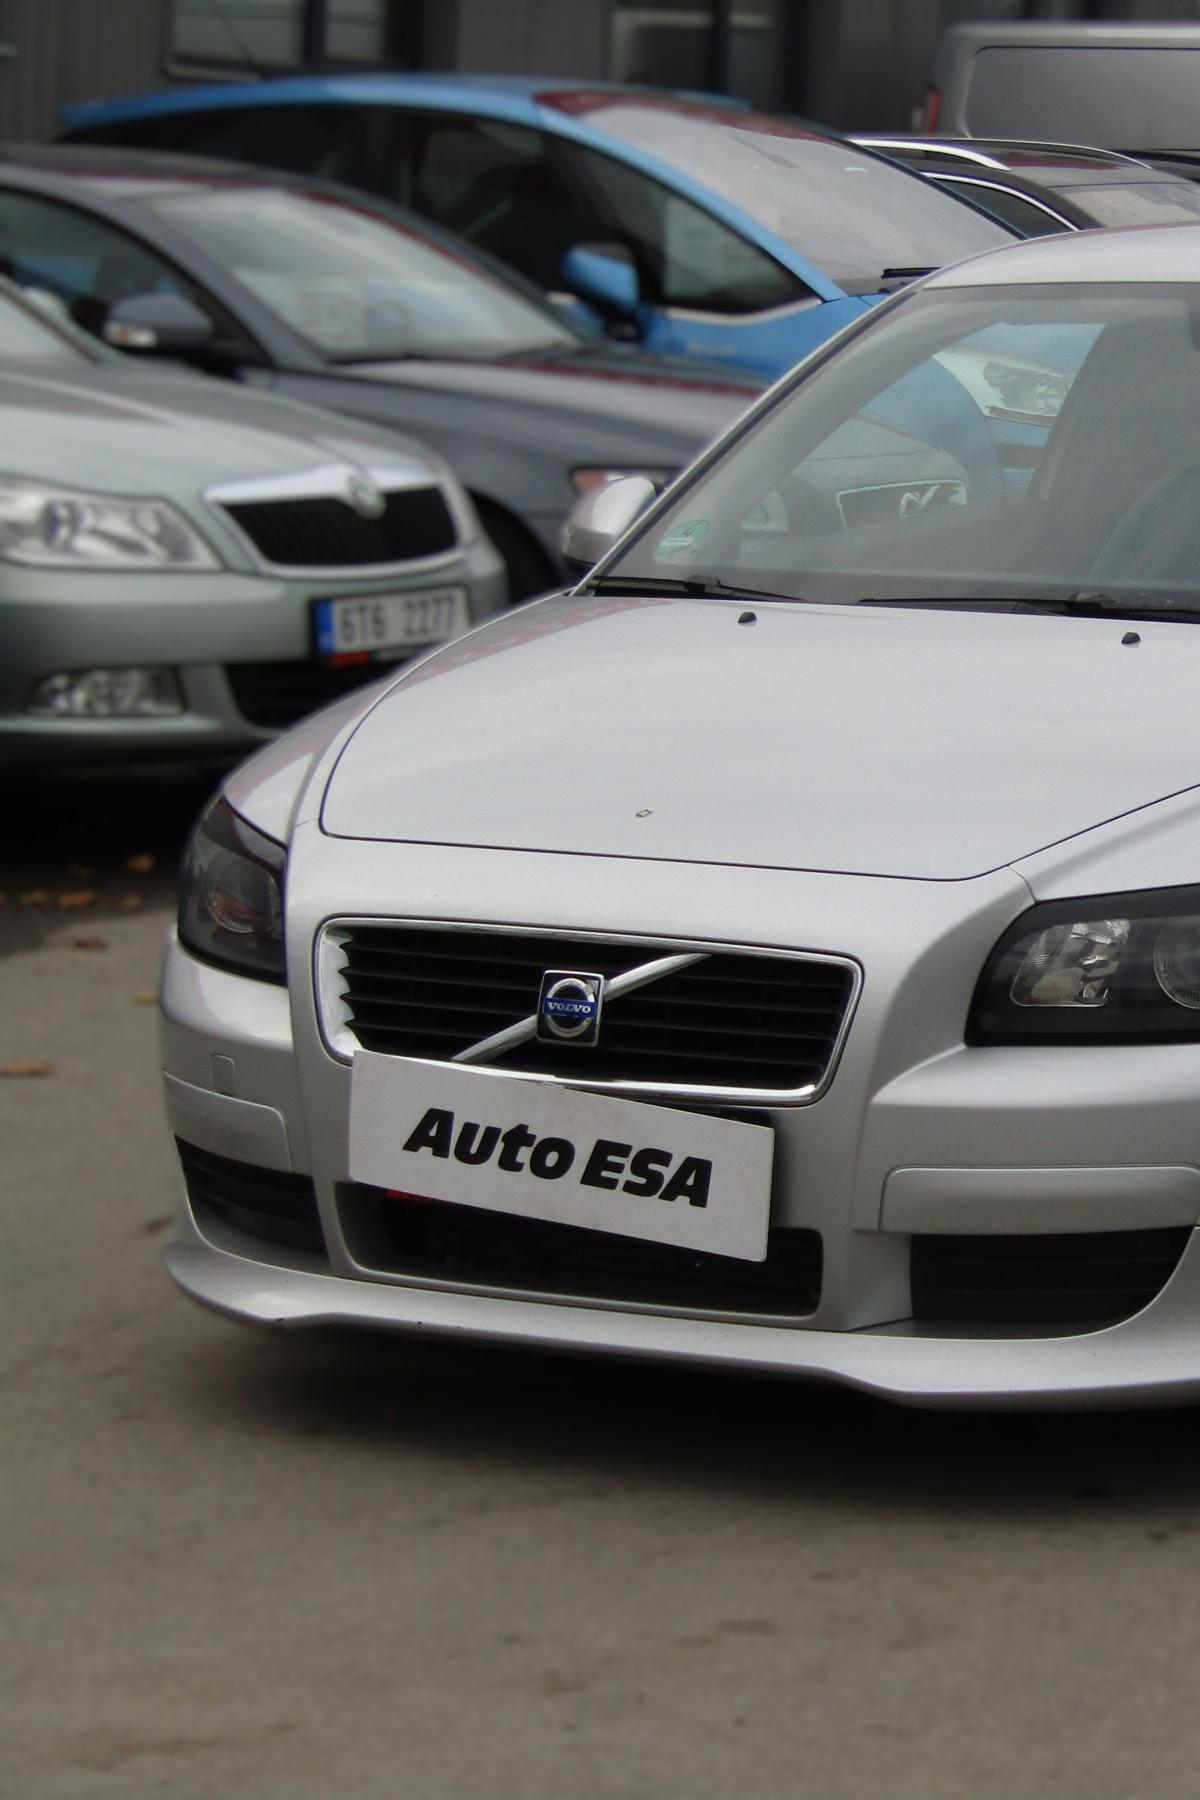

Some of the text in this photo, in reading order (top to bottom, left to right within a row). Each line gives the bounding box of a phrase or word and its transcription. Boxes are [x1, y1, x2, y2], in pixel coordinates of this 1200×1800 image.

[404, 596, 454, 636] 2277
[547, 1001, 592, 1014] VOLVO
[402, 1107, 713, 1208] Auto ESA
